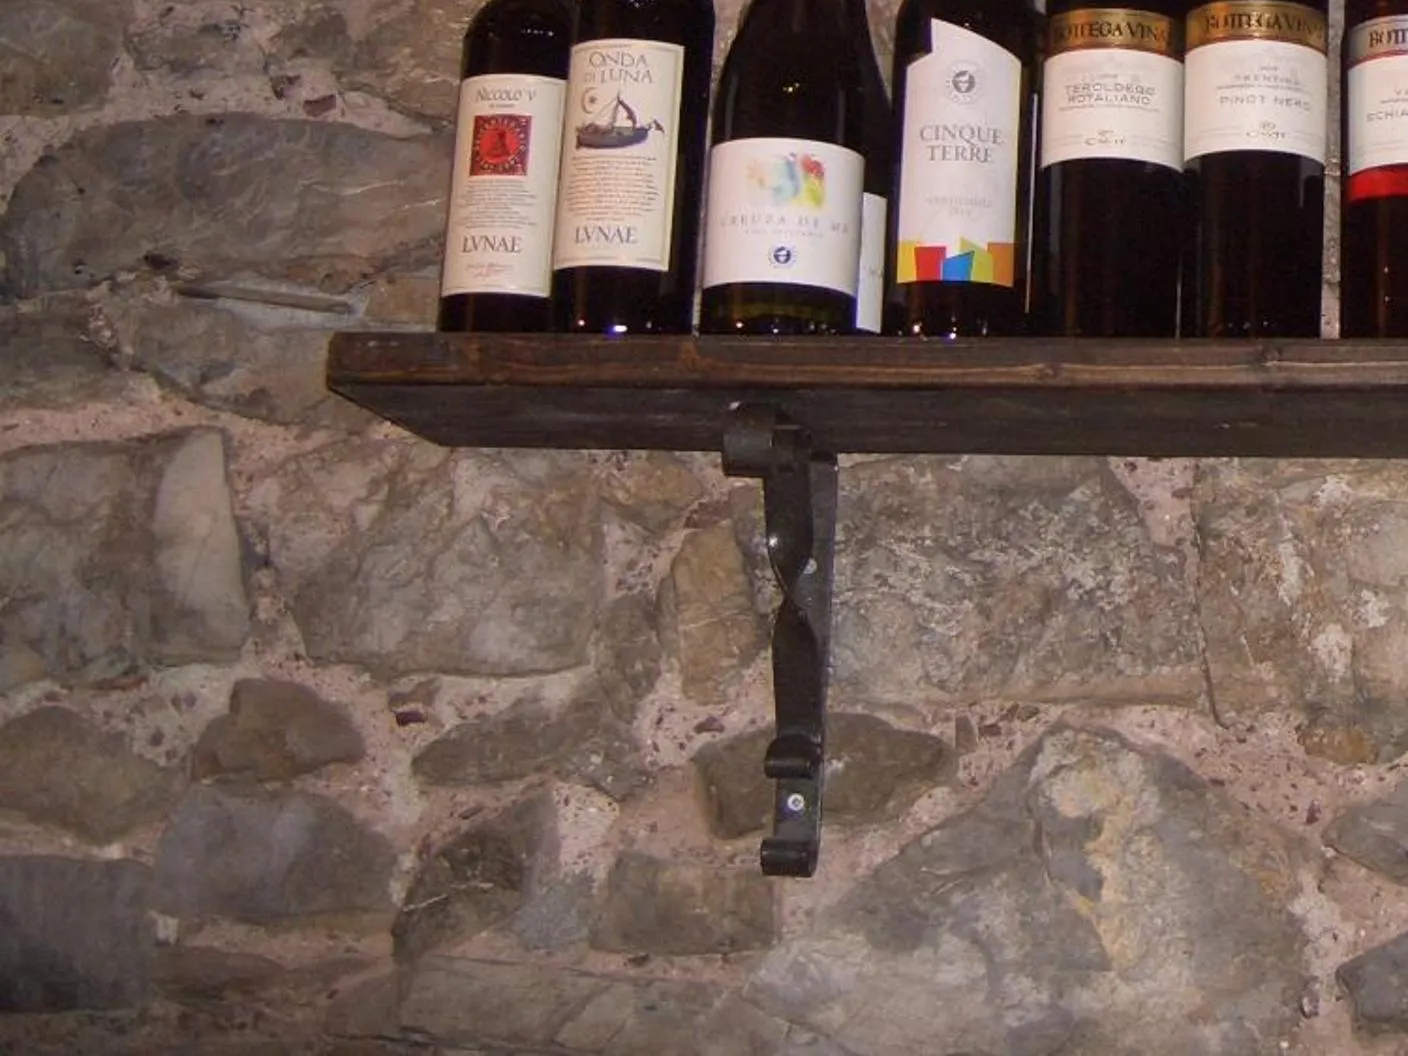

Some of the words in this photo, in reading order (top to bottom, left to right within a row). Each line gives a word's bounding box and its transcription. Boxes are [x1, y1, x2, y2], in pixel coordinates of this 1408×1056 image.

[589, 51, 650, 69] ONDA
[600, 68, 653, 84] LUNA
[919, 124, 1005, 147] CINQUE
[926, 145, 993, 163] TERRE
